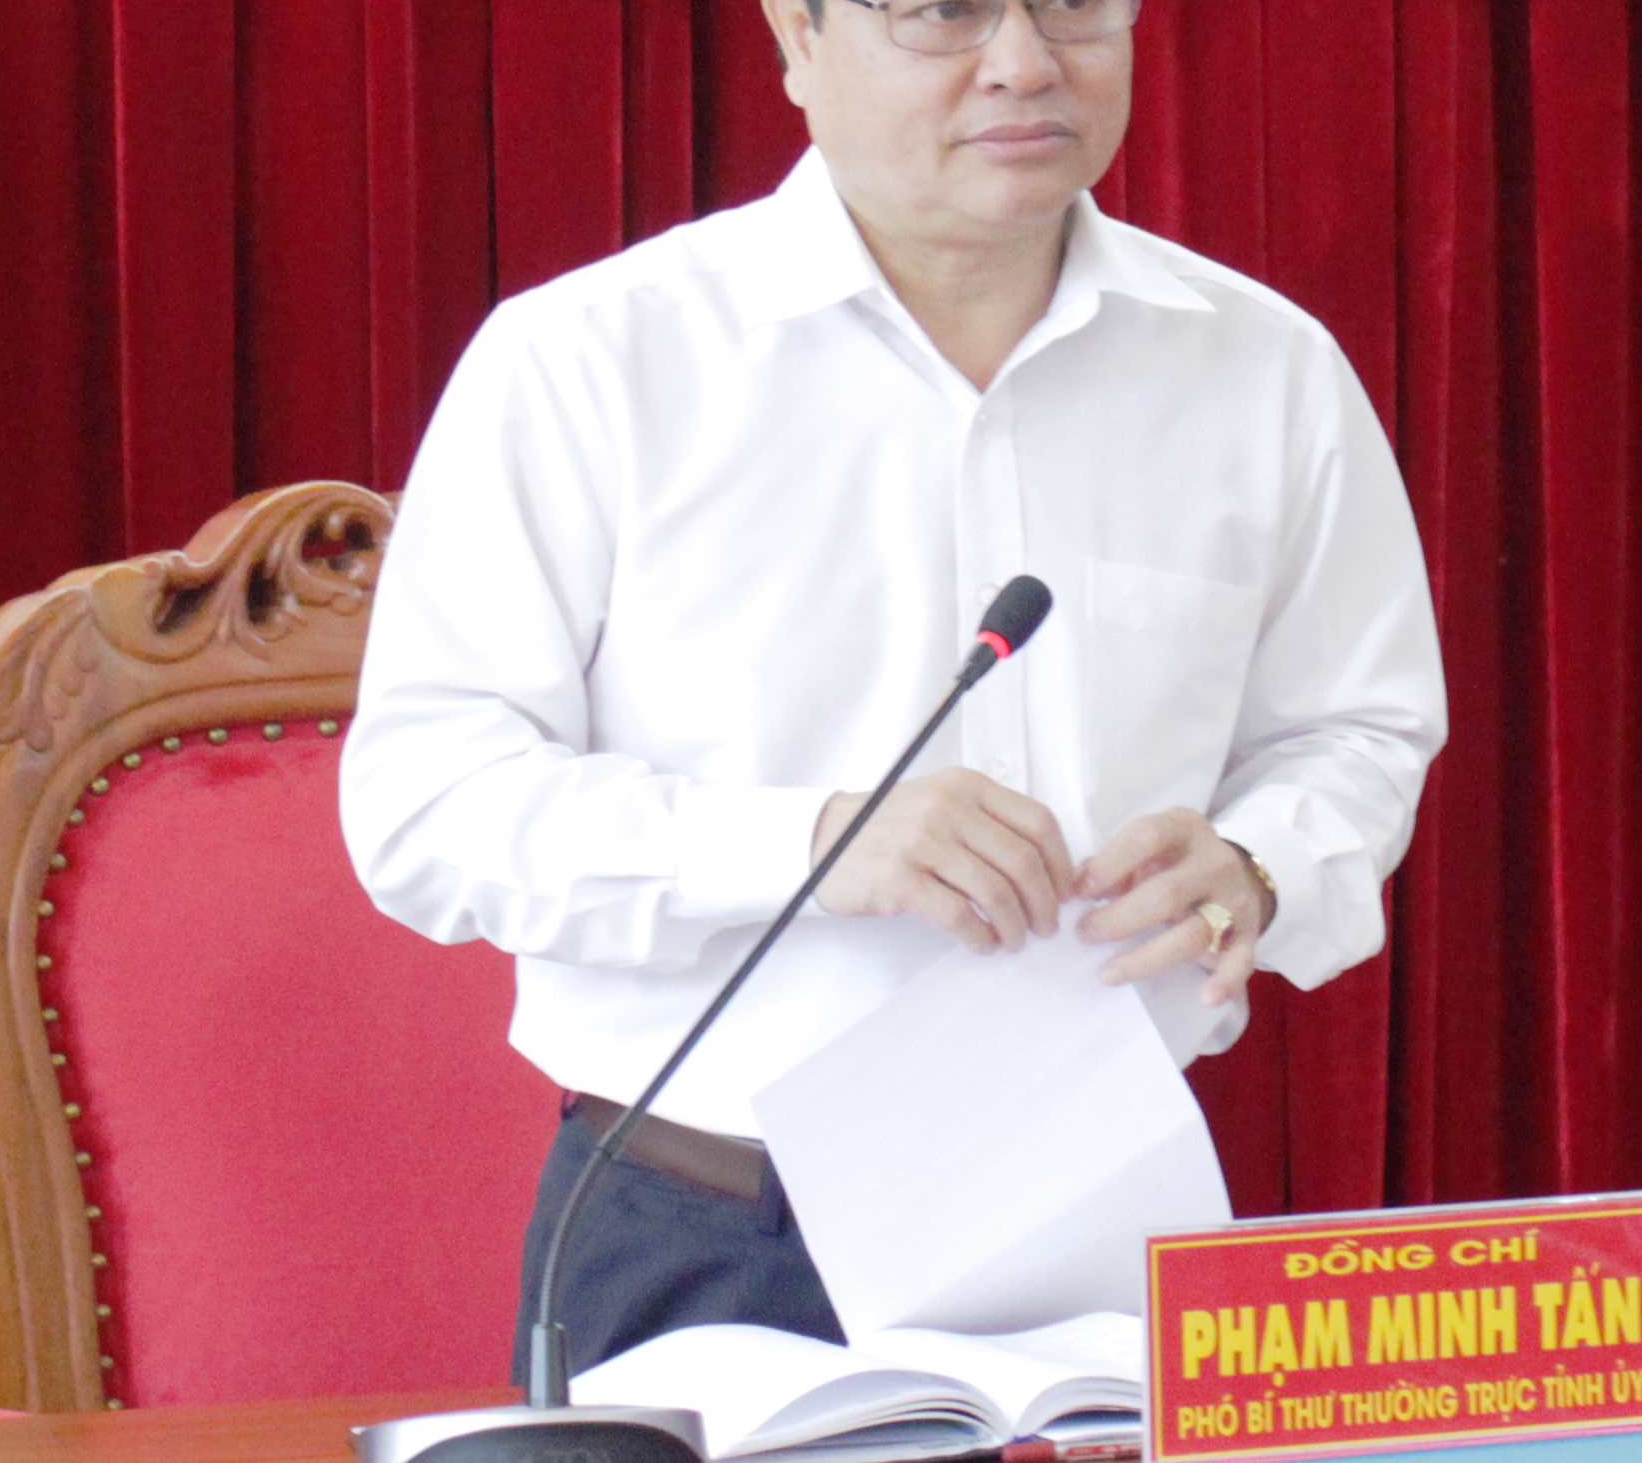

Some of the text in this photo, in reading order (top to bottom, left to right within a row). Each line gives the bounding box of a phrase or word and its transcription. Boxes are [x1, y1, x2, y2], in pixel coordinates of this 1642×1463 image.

[1285, 1228, 1539, 1278] ĐỒNG CHÍ
[1181, 1262, 1642, 1387] PHẠM MINH TẤN
[1178, 1394, 1239, 1438] PHÓ
[1246, 1390, 1275, 1433] BÍ
[1280, 1389, 1337, 1430] THƯ
[1340, 1379, 1459, 1425] THƯỜNG
[1464, 1375, 1538, 1422] TRỰC
[1542, 1363, 1605, 1409] TỈNH
